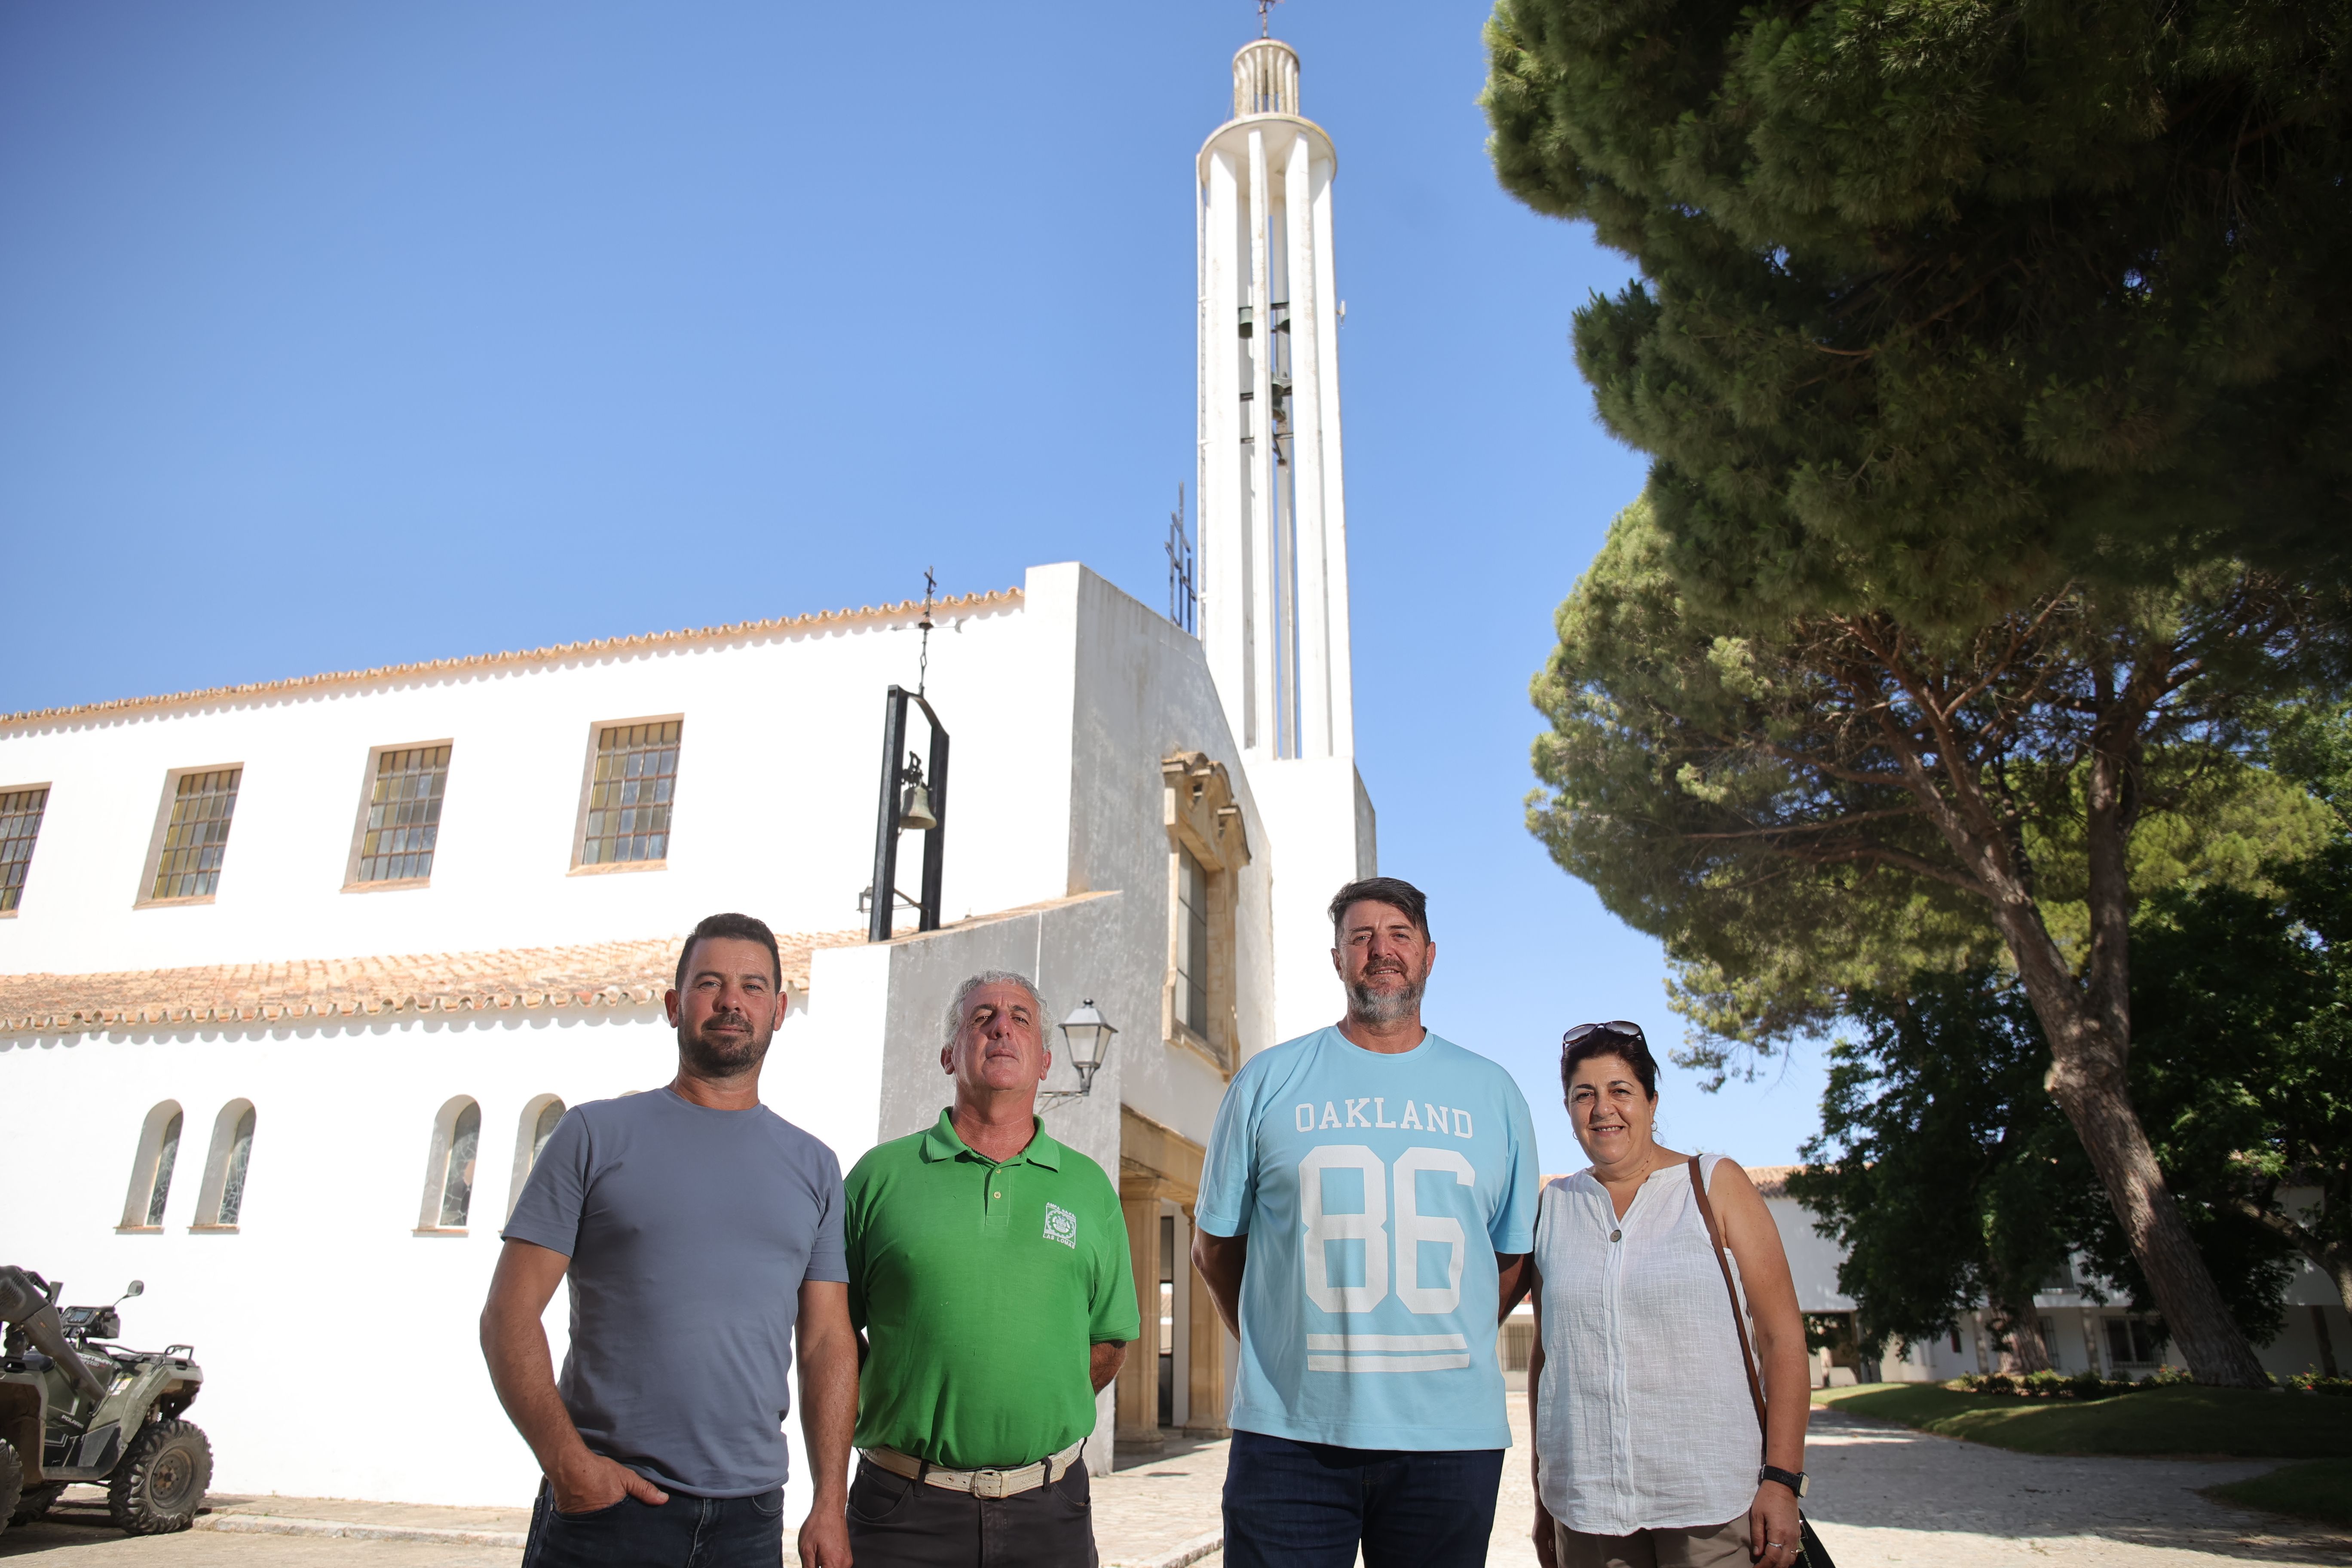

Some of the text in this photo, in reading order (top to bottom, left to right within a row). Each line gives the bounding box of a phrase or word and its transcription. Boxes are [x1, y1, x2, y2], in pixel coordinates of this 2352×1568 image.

[1295, 1097, 1473, 1139] OAKLAND
[1046, 1202, 1060, 1210] AMPA
[1298, 1145, 1476, 1314] 86
[1057, 1237, 1075, 1249] LOMAS
[61, 1415, 84, 1429] POLARIS
